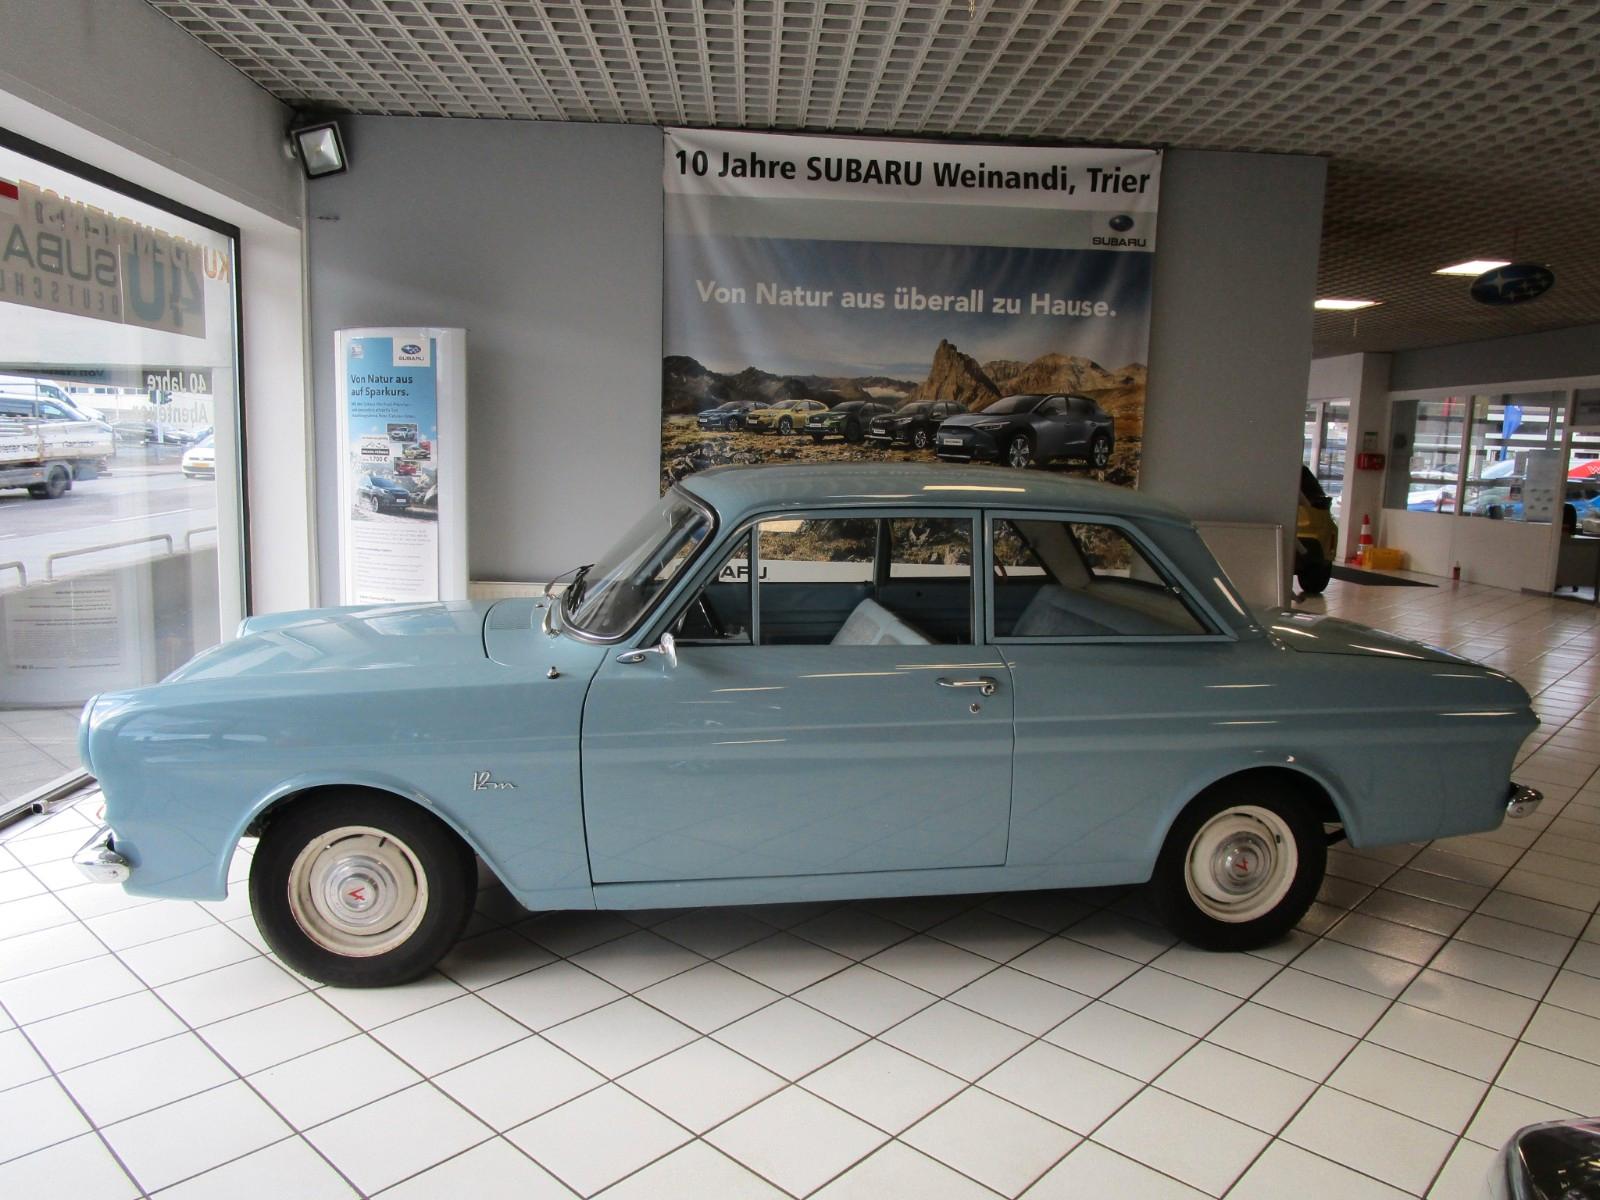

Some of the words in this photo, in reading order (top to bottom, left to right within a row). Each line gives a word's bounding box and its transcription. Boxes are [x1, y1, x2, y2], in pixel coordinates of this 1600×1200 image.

[675, 149, 709, 177] 10
[718, 151, 797, 180] Jahre
[806, 156, 923, 187] SUBARU
[933, 162, 1076, 196] Weinandi,
[1086, 166, 1151, 194] Trier
[1091, 235, 1147, 248] SUBARU
[696, 280, 746, 305] Von
[756, 282, 833, 308] Natur
[840, 291, 886, 310] aus
[893, 286, 984, 313] überall
[991, 297, 1021, 315] zu
[1029, 293, 1117, 318] Hause.
[351, 374, 366, 384] Von
[367, 374, 393, 384] Natur
[395, 375, 414, 384] aus
[351, 387, 364, 396] auf
[365, 386, 409, 399] Sparkurs.
